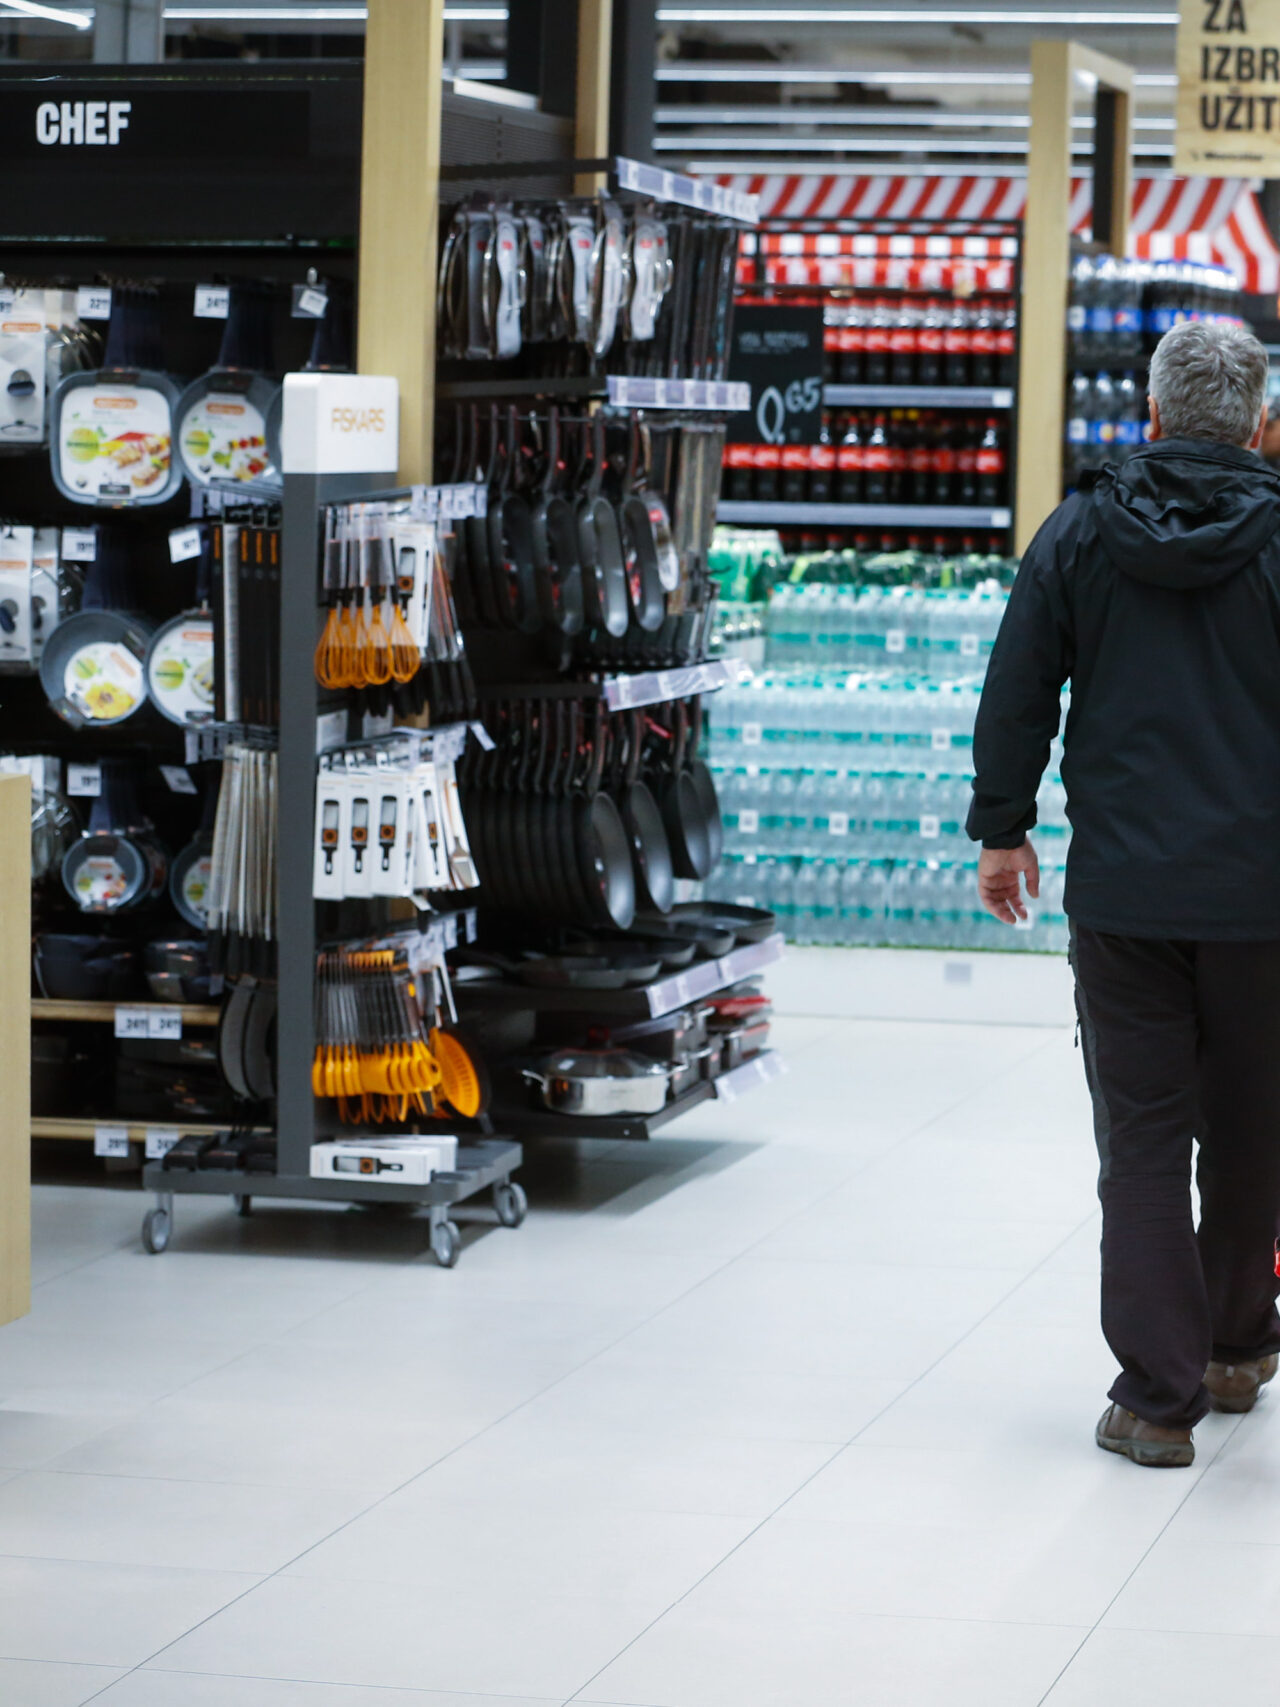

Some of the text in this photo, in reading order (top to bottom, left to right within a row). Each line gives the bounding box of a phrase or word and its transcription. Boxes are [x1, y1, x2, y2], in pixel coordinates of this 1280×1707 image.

[1202, 0, 1246, 33] ZA
[36, 101, 132, 145] CHEF
[331, 407, 385, 433] FISKARS
